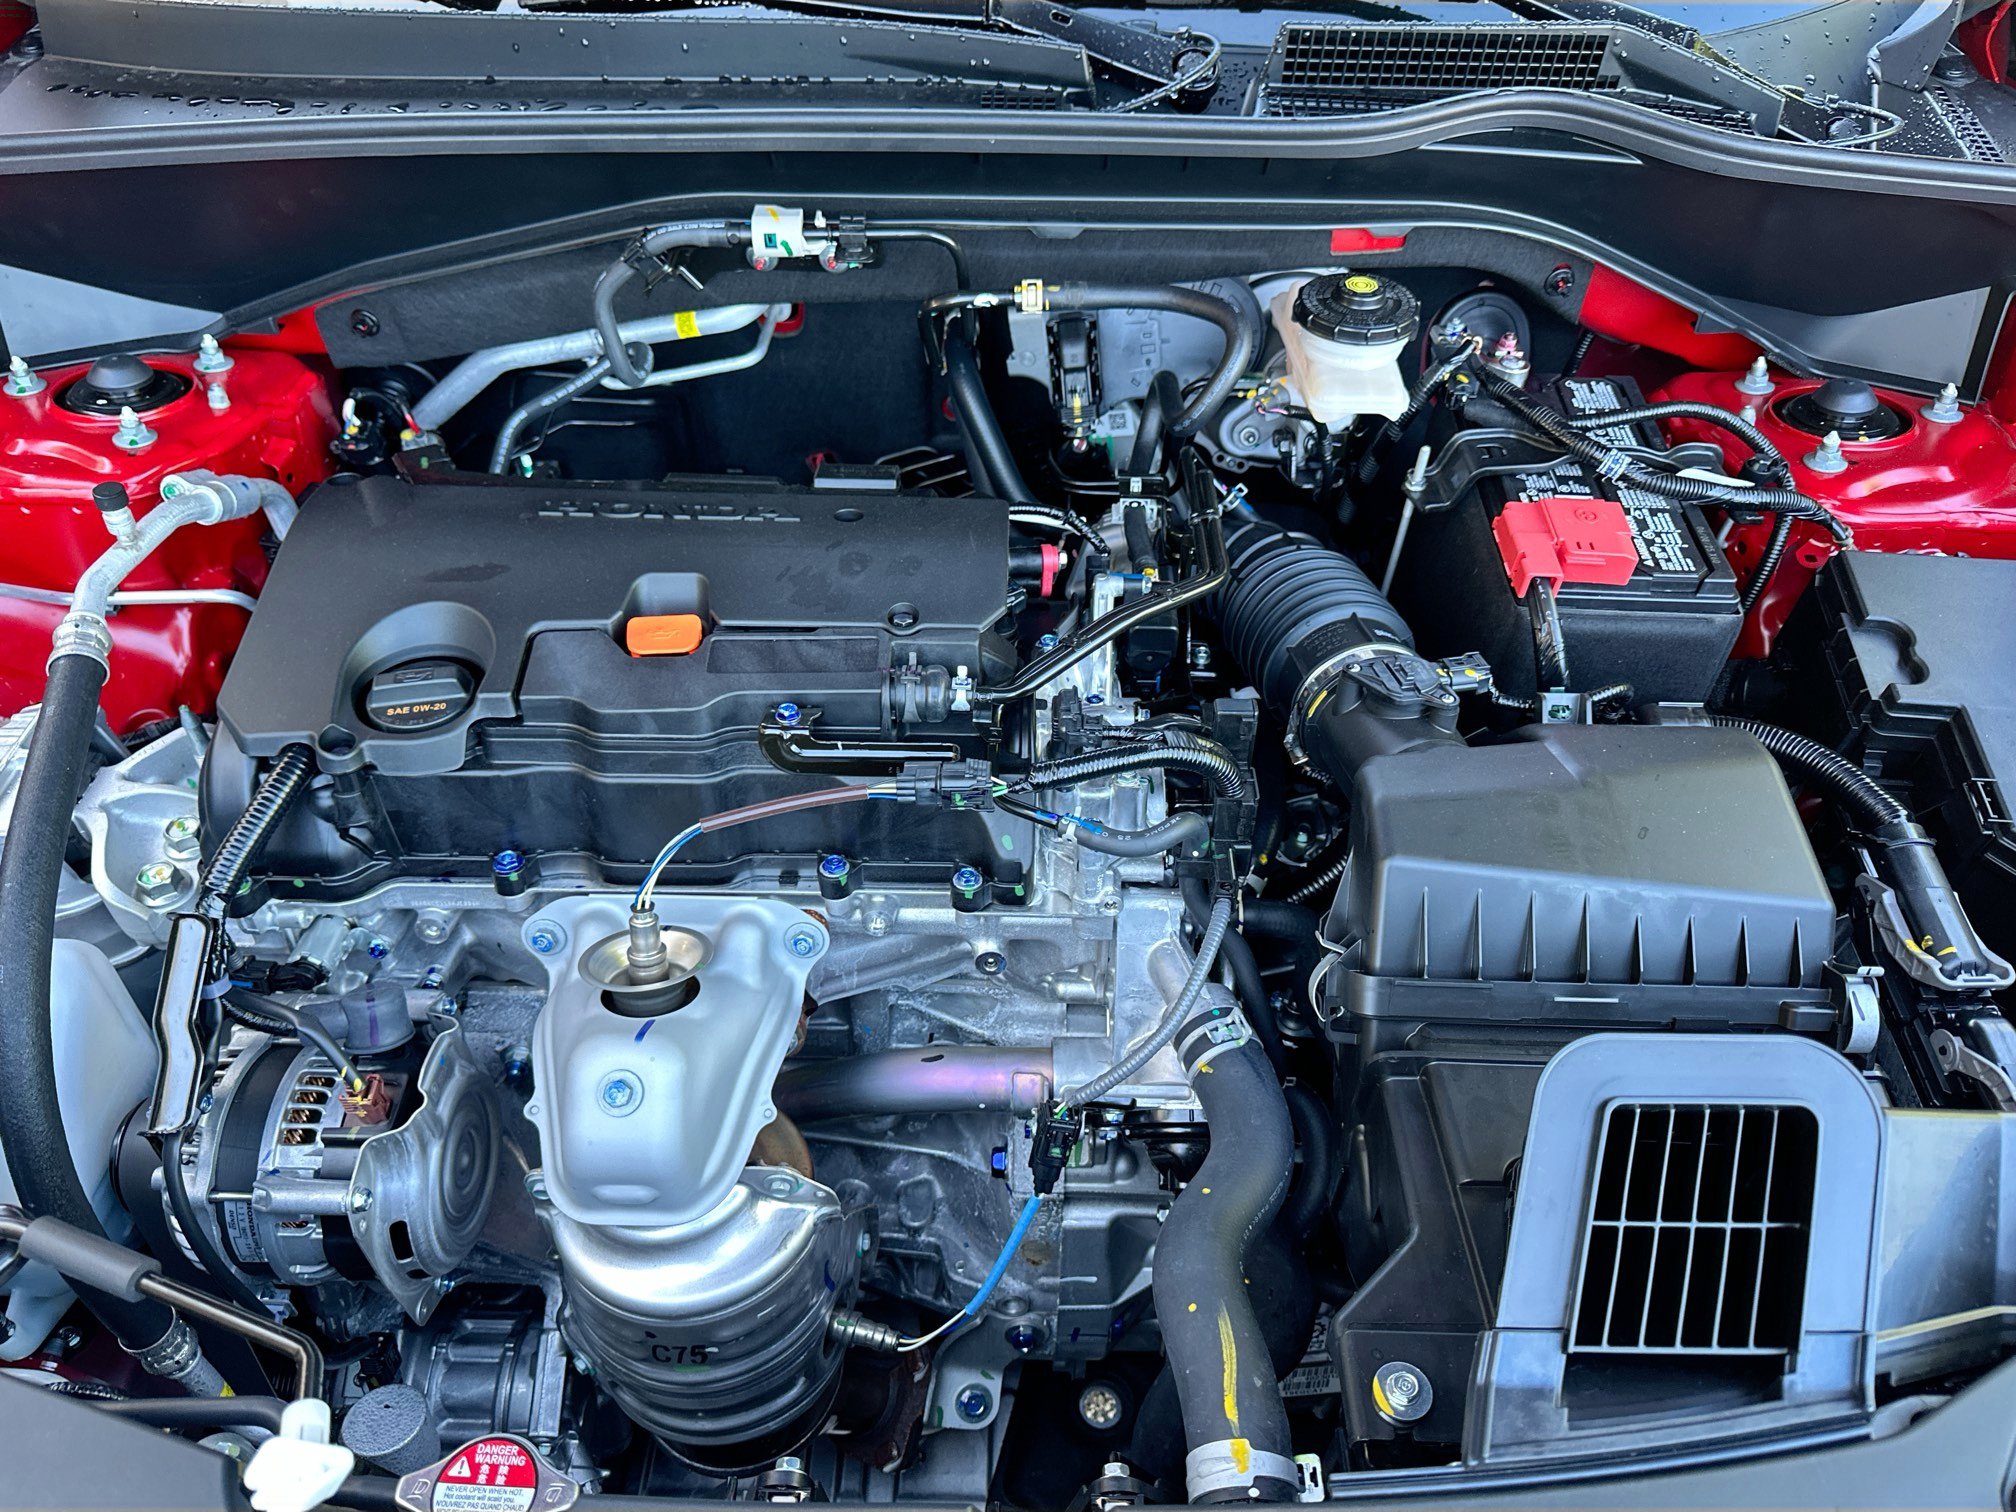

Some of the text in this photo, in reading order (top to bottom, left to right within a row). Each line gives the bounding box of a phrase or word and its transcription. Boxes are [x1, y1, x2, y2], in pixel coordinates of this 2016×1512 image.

[538, 501, 801, 522] HONDA
[386, 702, 447, 716] SAE 0W-20
[651, 1344, 709, 1364] C75
[477, 1444, 519, 1456] DANGER
[475, 1454, 527, 1467] WARNUNG
[446, 1485, 468, 1494] NEVER
[469, 1486, 487, 1494] OPEN
[489, 1487, 508, 1495] WHEN
[466, 1501, 479, 1509] PAS
[480, 1502, 502, 1511] QUAND
